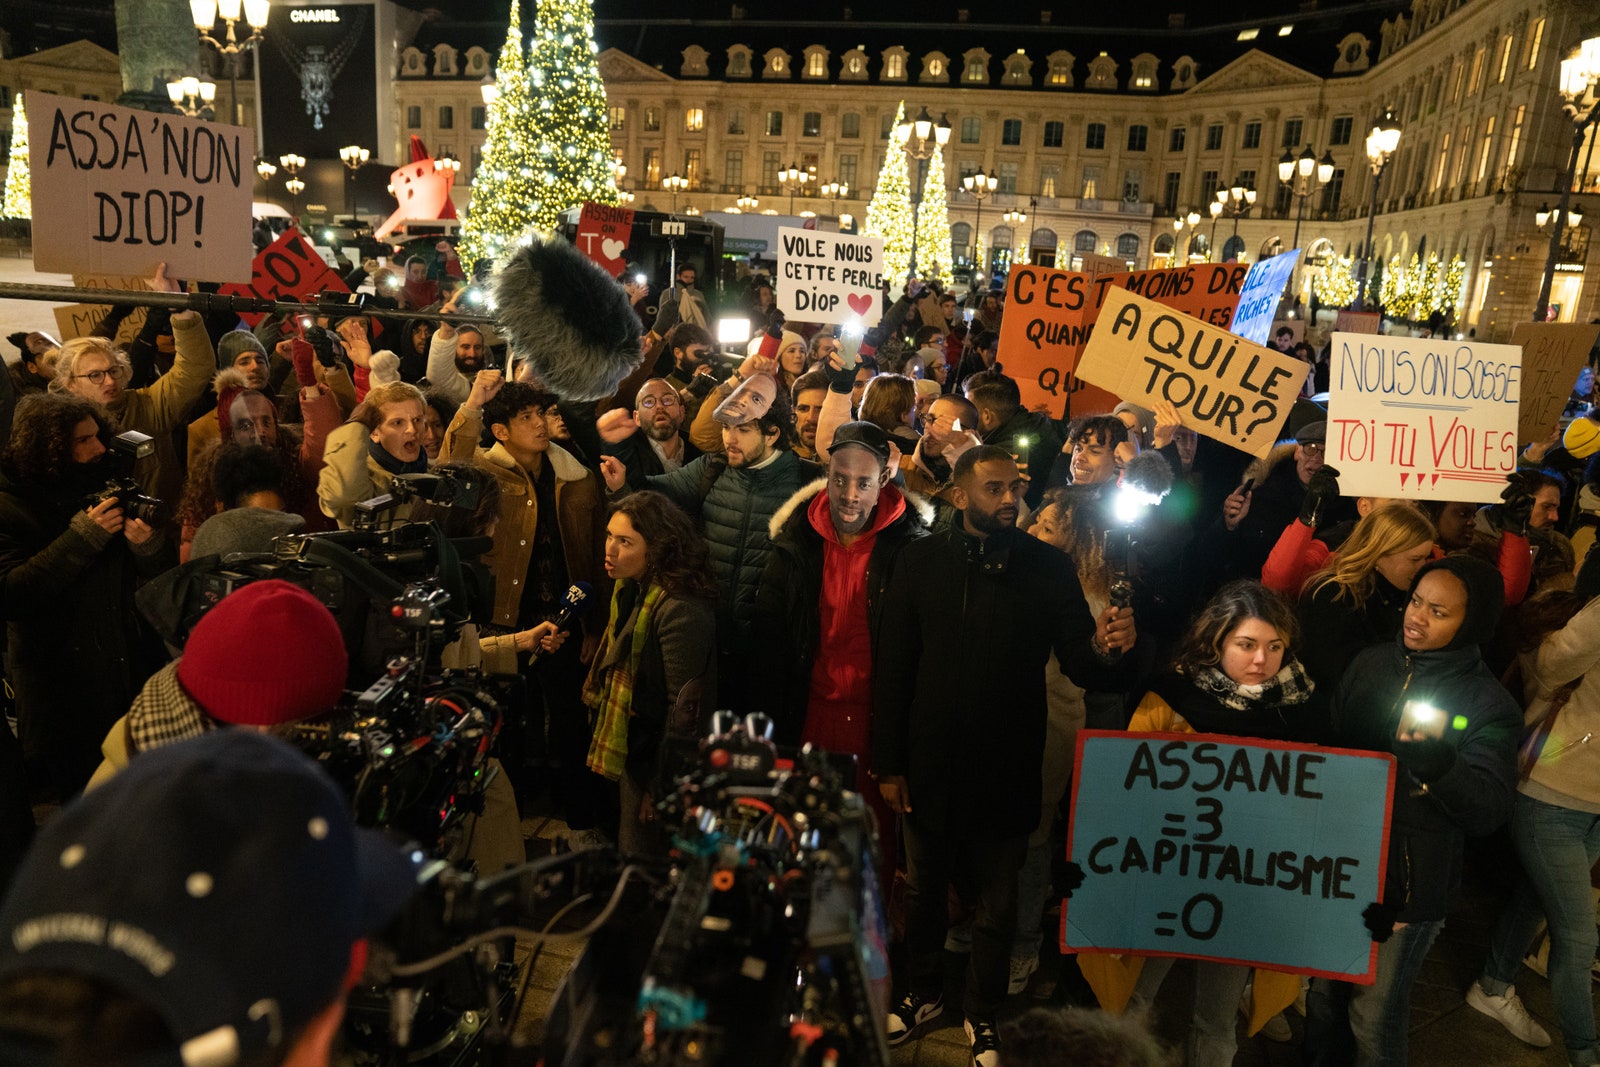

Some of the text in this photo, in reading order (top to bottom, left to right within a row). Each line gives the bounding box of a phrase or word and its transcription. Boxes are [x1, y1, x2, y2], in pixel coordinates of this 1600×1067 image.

[290, 9, 340, 23] CHANEL
[92, 189, 204, 248] DIOP!
[585, 203, 631, 226] ASSANE
[602, 223, 616, 234] ON
[784, 234, 826, 258] VOLE
[835, 244, 873, 263] NOUS
[785, 261, 884, 291] CETTE PERLE
[1112, 303, 1141, 341] A
[1239, 354, 1292, 400] LE
[1340, 342, 1416, 396] NOUS
[1421, 352, 1448, 396] ON
[1144, 356, 1277, 443] TOUR?
[1429, 416, 1515, 472] VOLES
[569, 585, 586, 600] BFM
[405, 608, 422, 617] TSF
[733, 754, 760, 769] TSF
[1124, 741, 1326, 800] ASSANE
[1087, 836, 1359, 900] CAPITALISME
